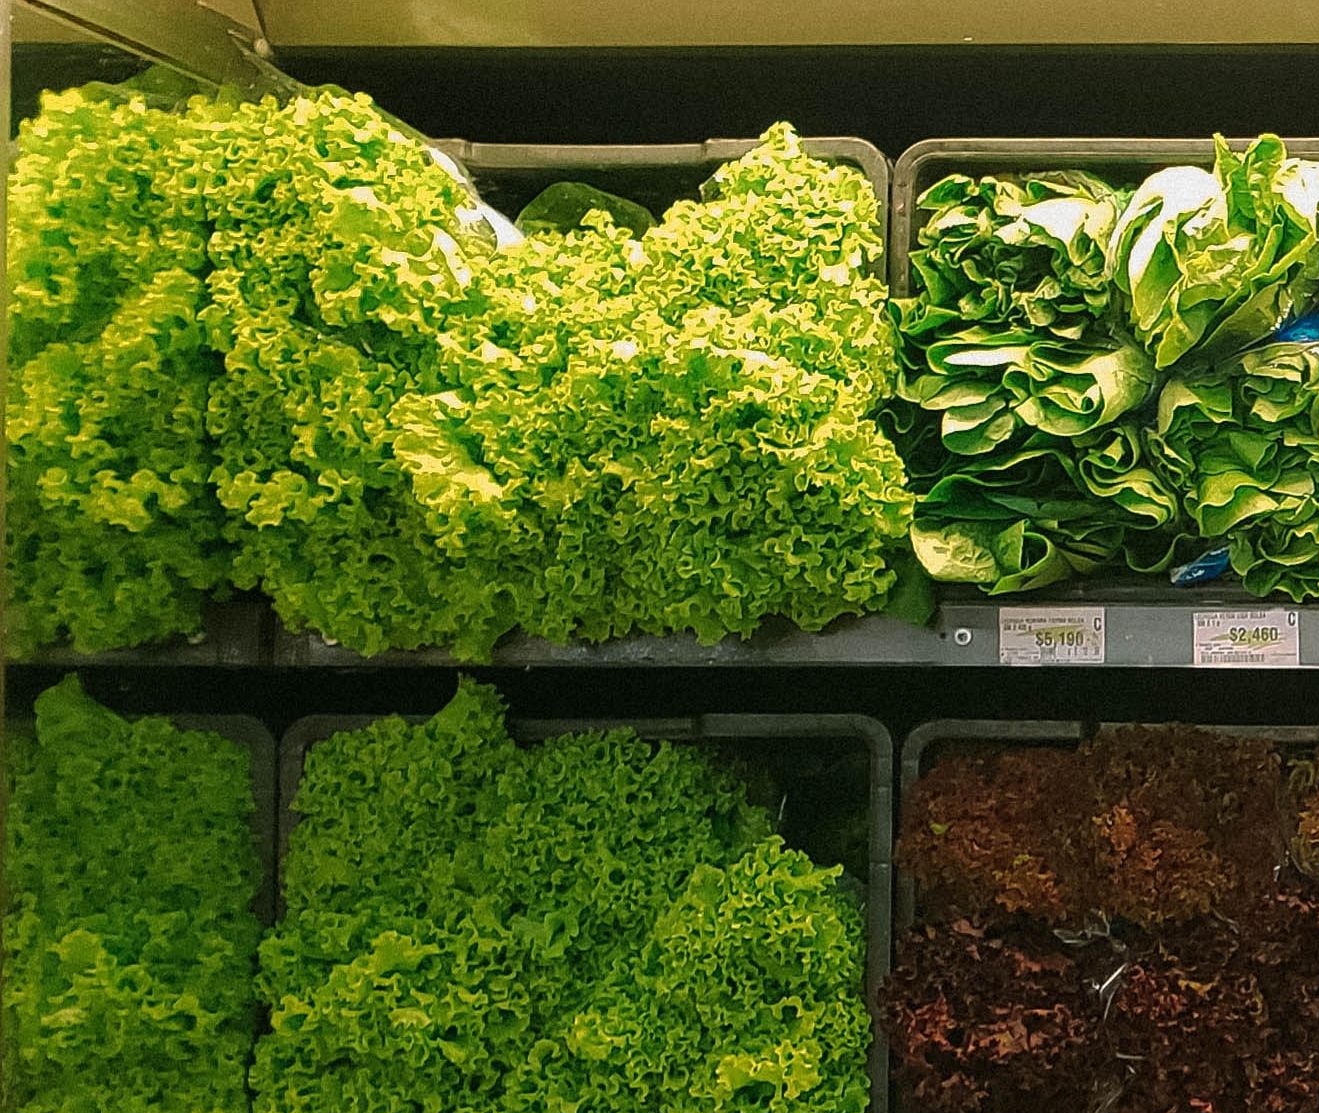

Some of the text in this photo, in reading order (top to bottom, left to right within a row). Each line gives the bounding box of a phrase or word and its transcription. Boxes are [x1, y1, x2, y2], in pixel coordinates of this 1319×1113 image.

[1094, 618, 1101, 631] C
[1288, 612, 1295, 626] C
[1036, 632, 1084, 648] $5,190
[1229, 627, 1278, 643] $2,460
